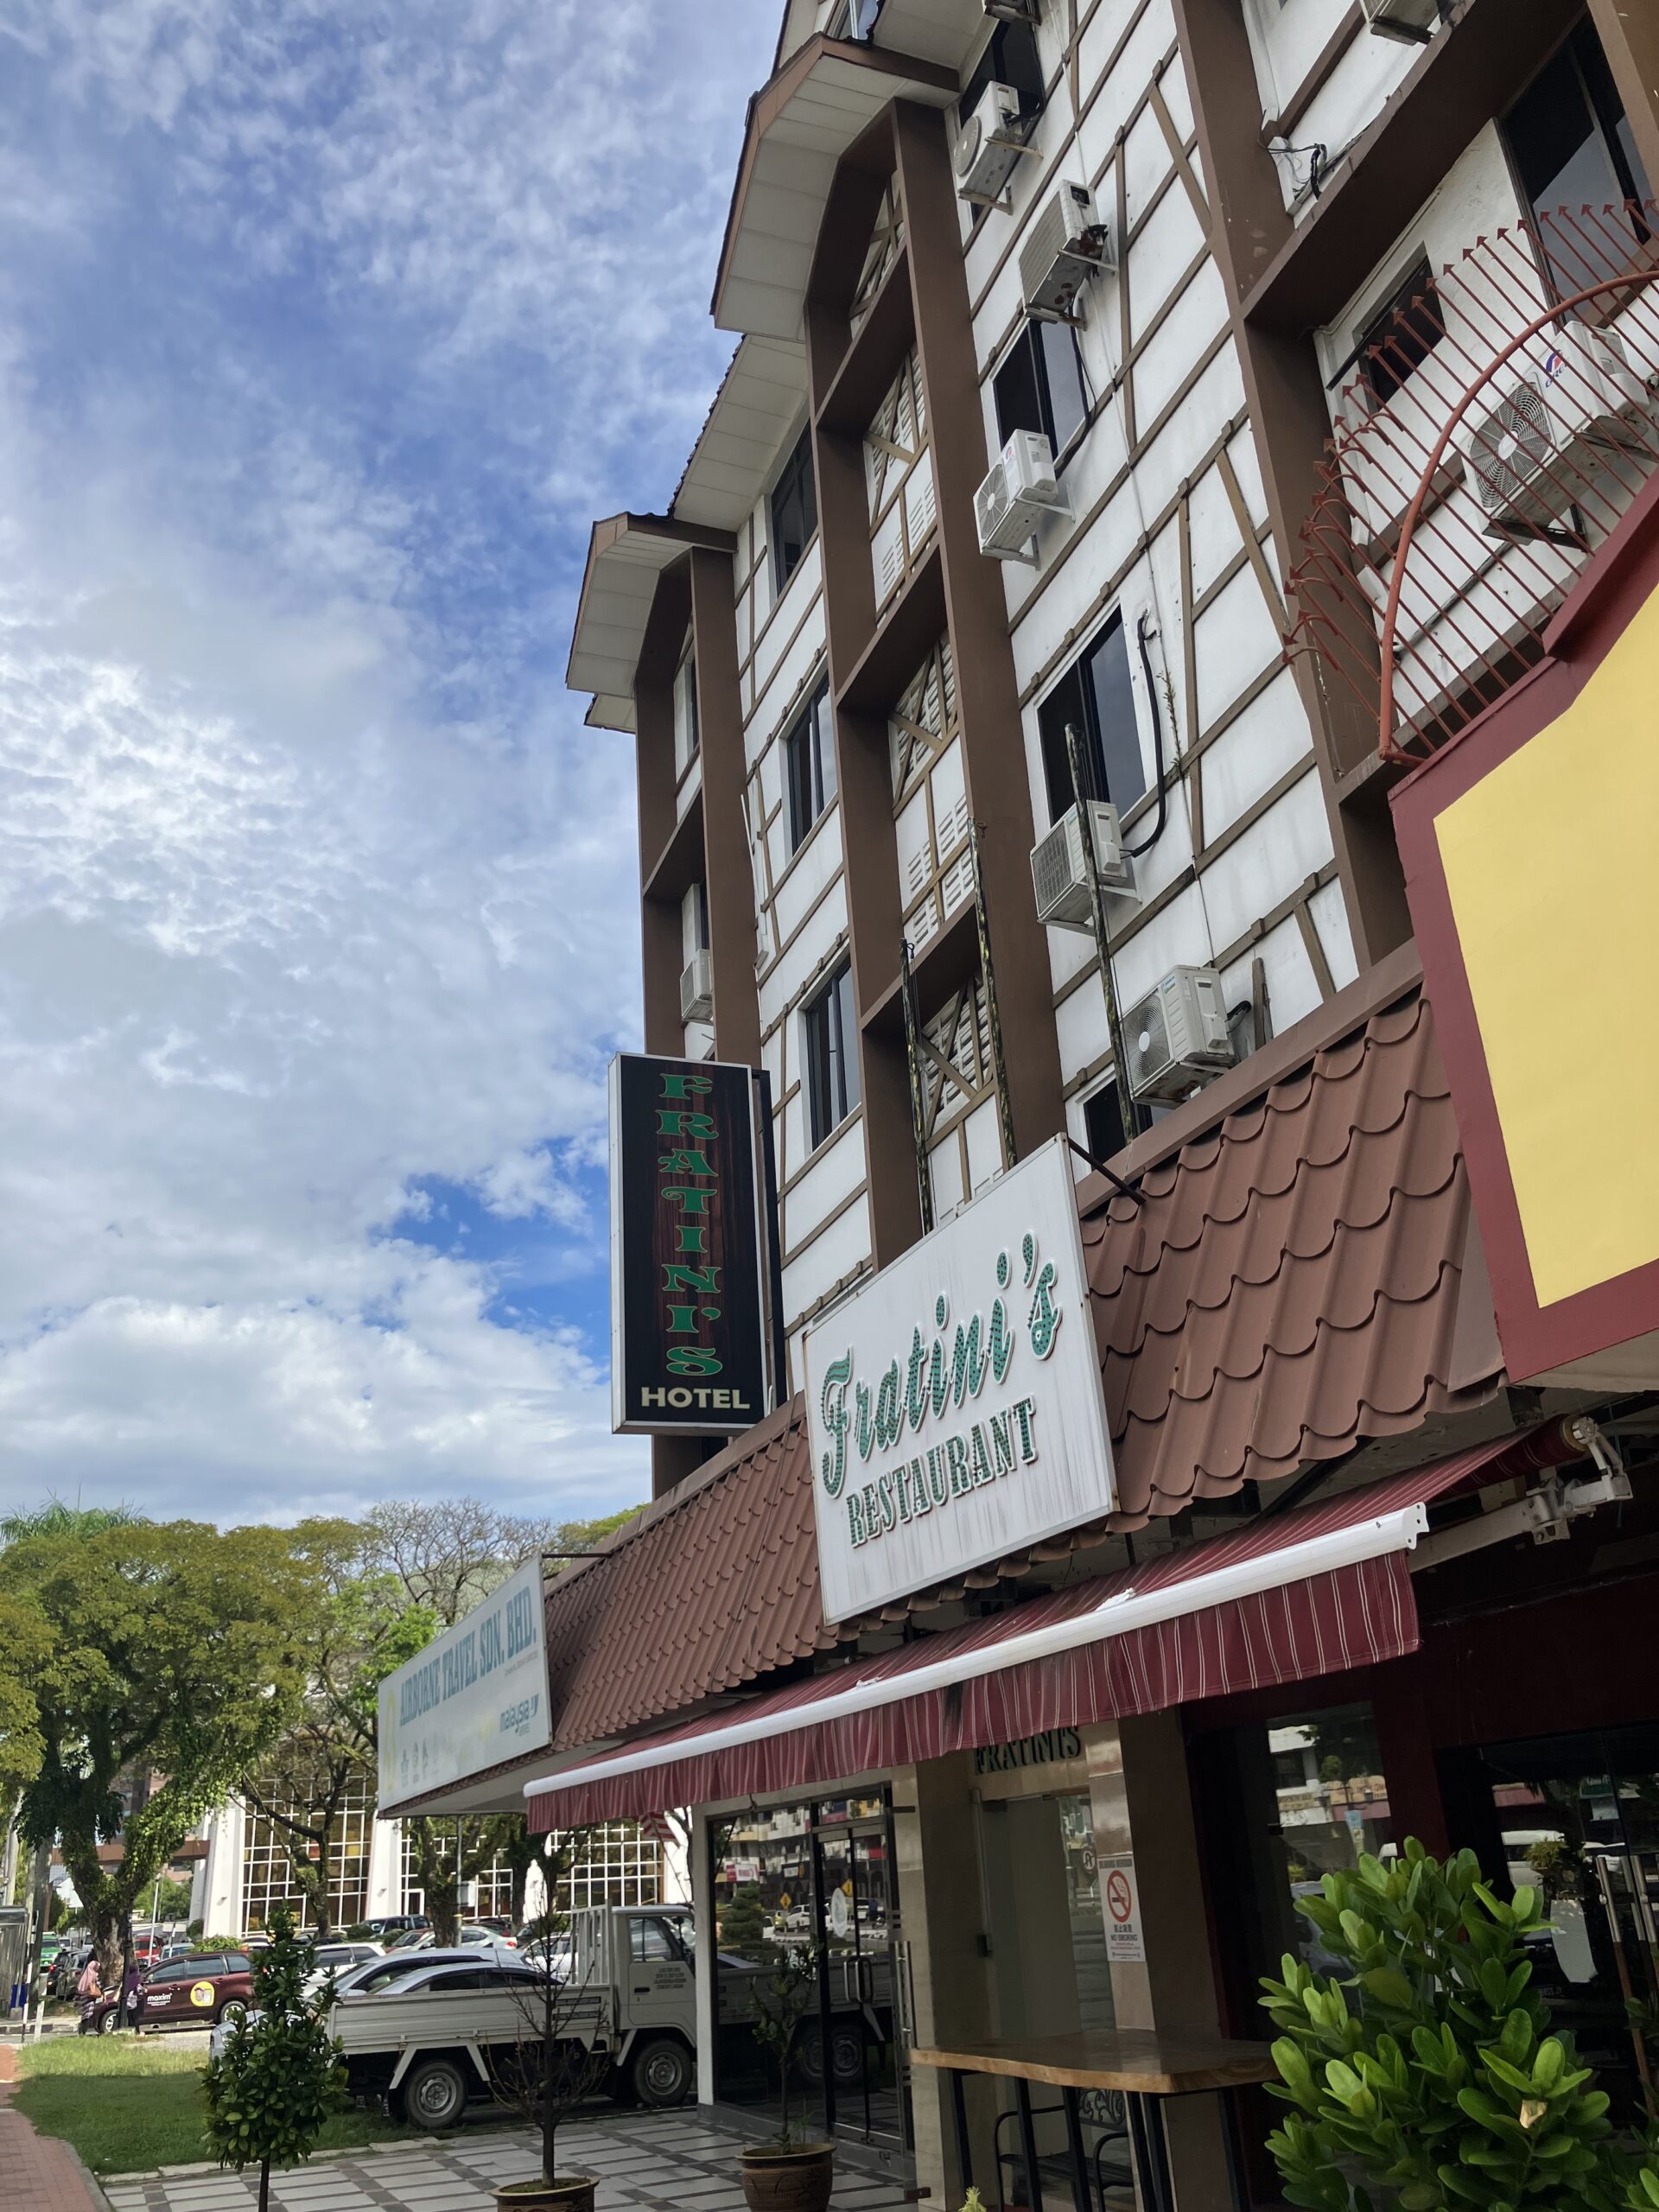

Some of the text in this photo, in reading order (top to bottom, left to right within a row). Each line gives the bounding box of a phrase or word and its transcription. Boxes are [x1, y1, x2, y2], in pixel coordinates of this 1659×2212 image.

[655, 1072, 723, 1376] FRATINI'S
[640, 1386, 750, 1409] HOTEL
[820, 1229, 1063, 1500] Fratini's
[845, 1394, 1039, 1548] RESTAURANT
[400, 1586, 537, 1728] AIRBORNE TRAVEL SDN. BHD.
[148, 1993, 170, 2001] maxim
